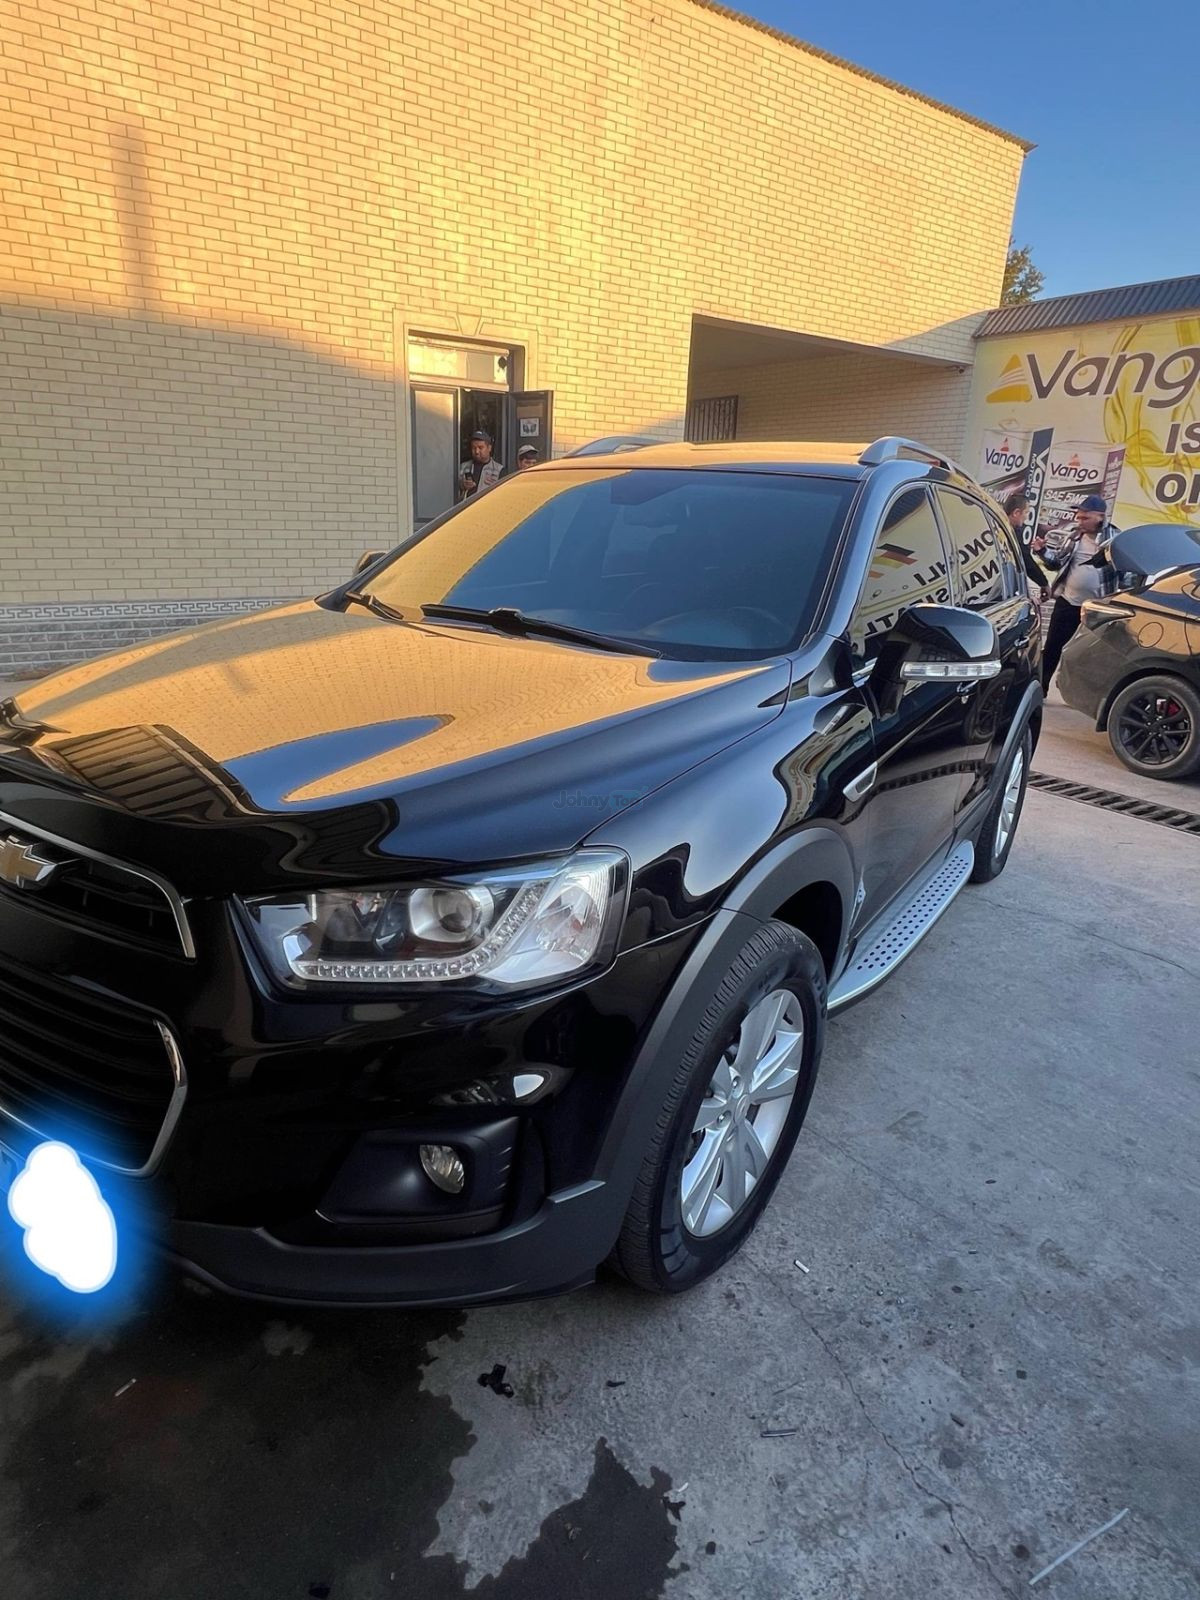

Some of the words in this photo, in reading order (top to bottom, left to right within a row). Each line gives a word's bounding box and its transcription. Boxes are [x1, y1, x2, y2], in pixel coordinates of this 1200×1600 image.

[985, 447, 1024, 472] Vango
[1050, 462, 1098, 482] Vango
[1048, 508, 1075, 520] MOTOR
